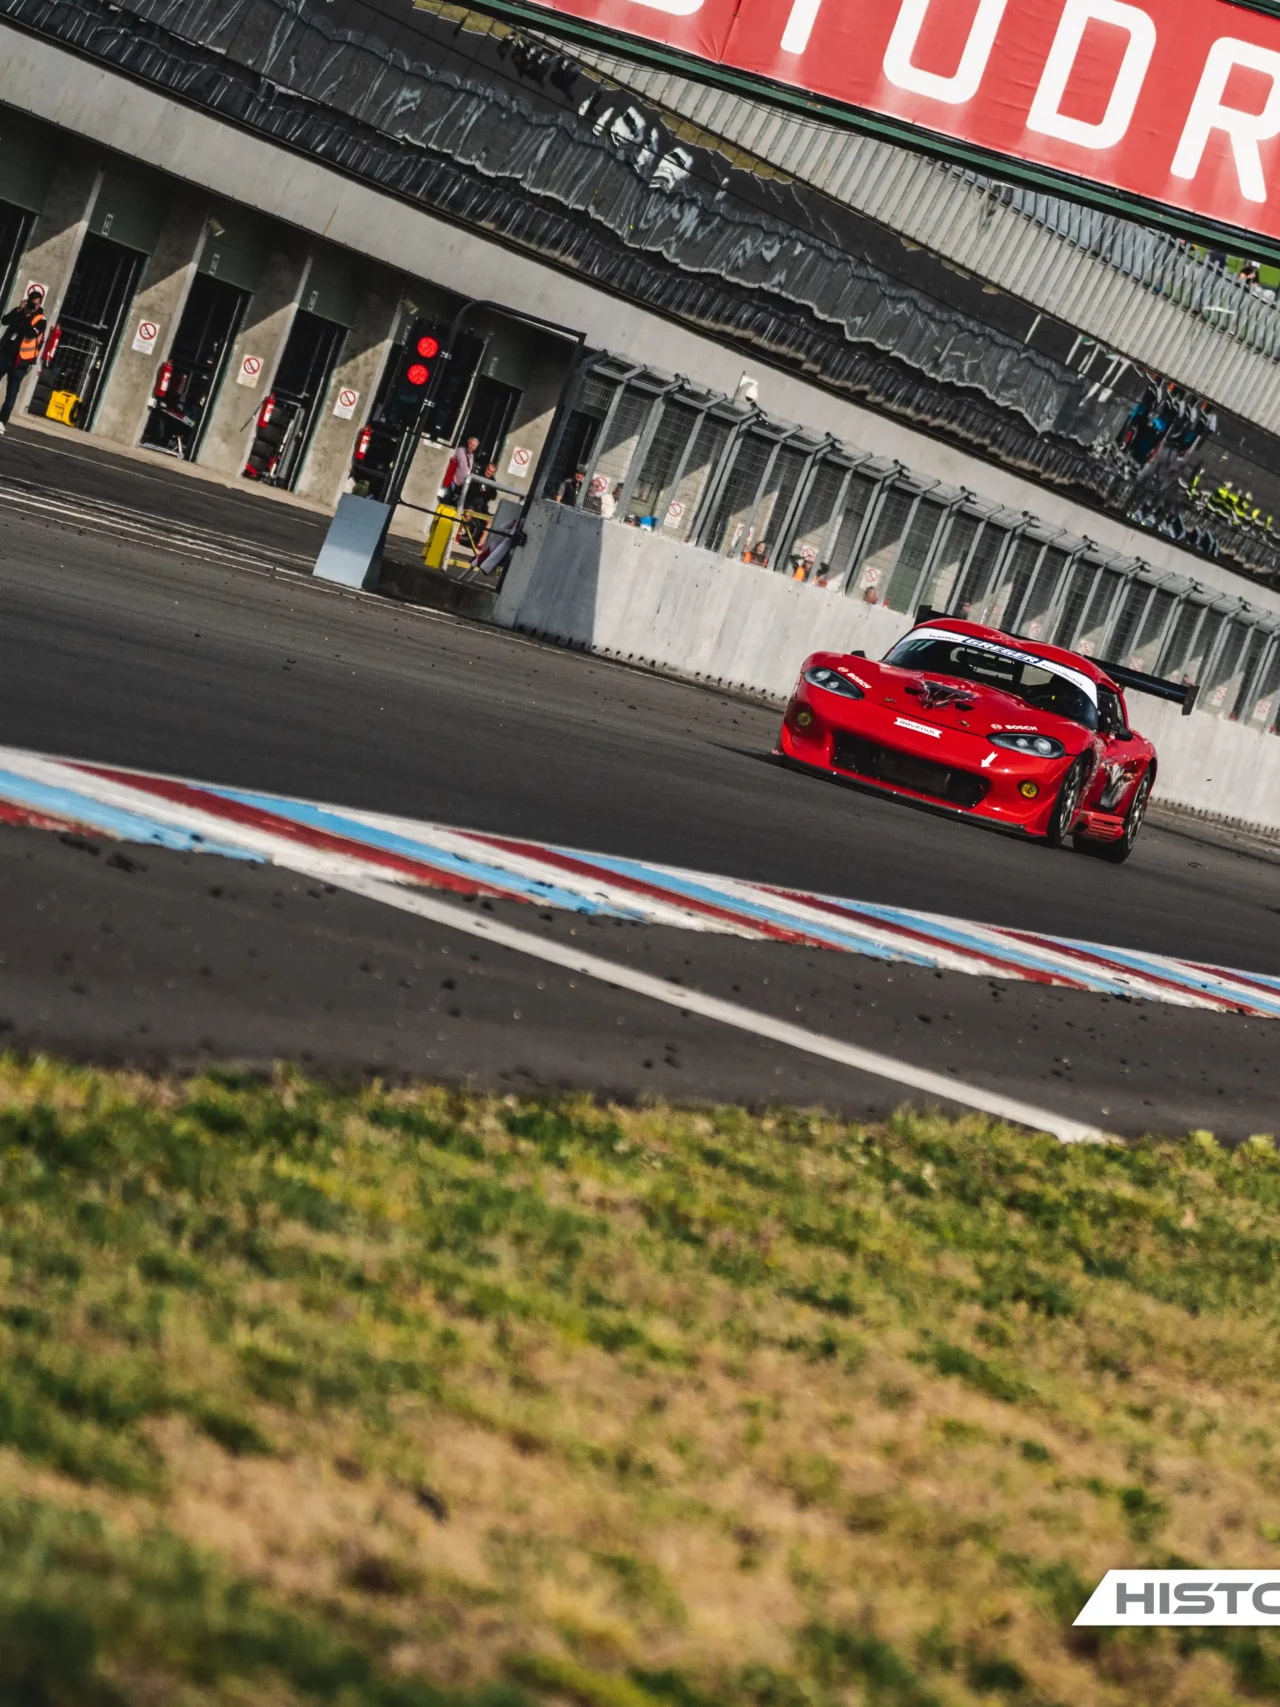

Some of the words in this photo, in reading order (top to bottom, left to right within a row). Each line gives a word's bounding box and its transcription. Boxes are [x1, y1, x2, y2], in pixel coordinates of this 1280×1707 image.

[965, 636, 1039, 664] GREGER
[846, 671, 872, 690] BOSCH
[1005, 723, 1037, 732] BOSCH
